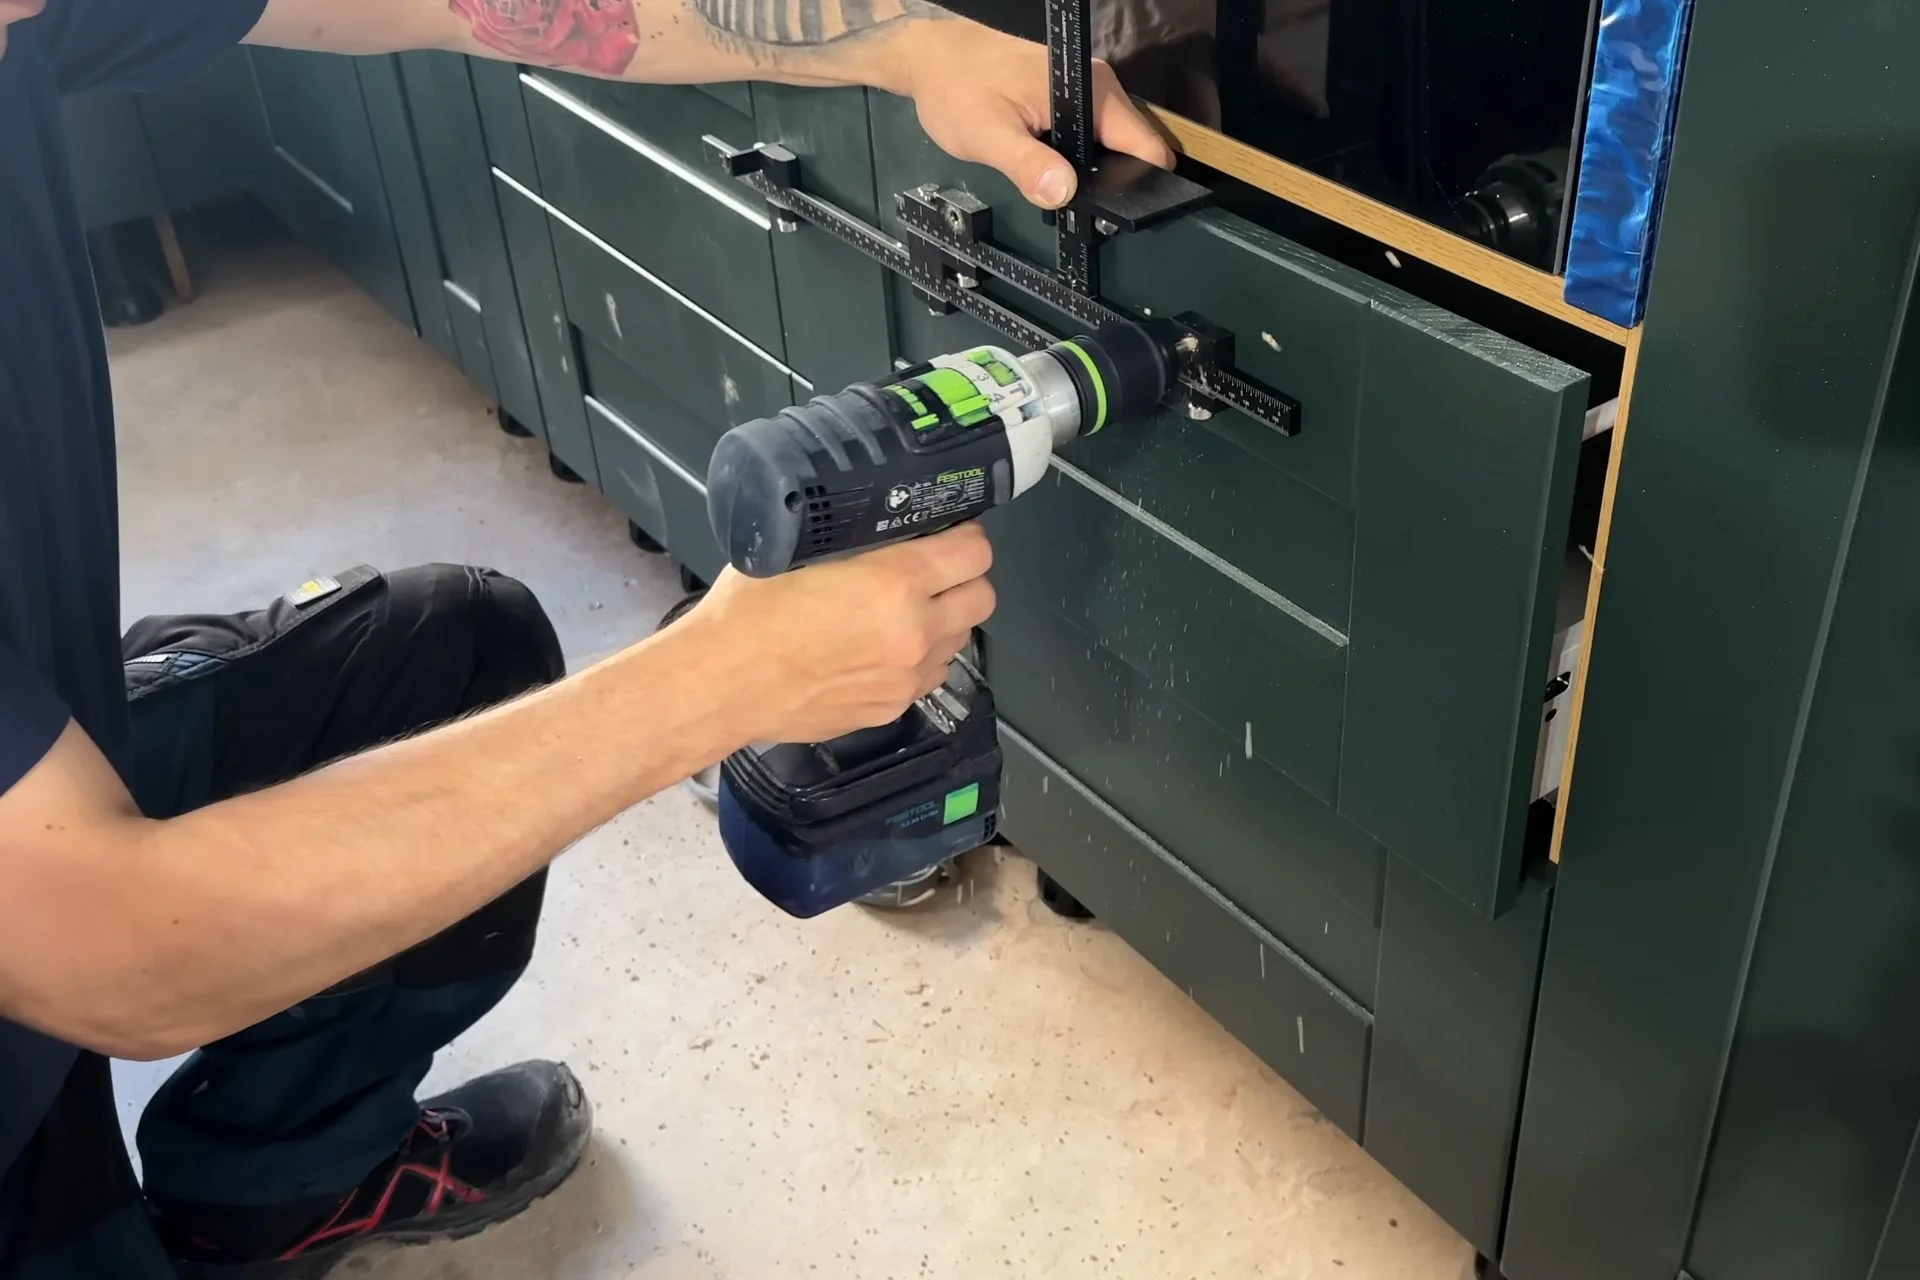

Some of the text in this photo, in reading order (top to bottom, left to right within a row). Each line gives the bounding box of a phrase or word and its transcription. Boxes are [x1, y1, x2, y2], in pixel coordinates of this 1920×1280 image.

[977, 373, 989, 382] 3
[991, 393, 1005, 403] 4
[936, 468, 985, 484] FESTOOL
